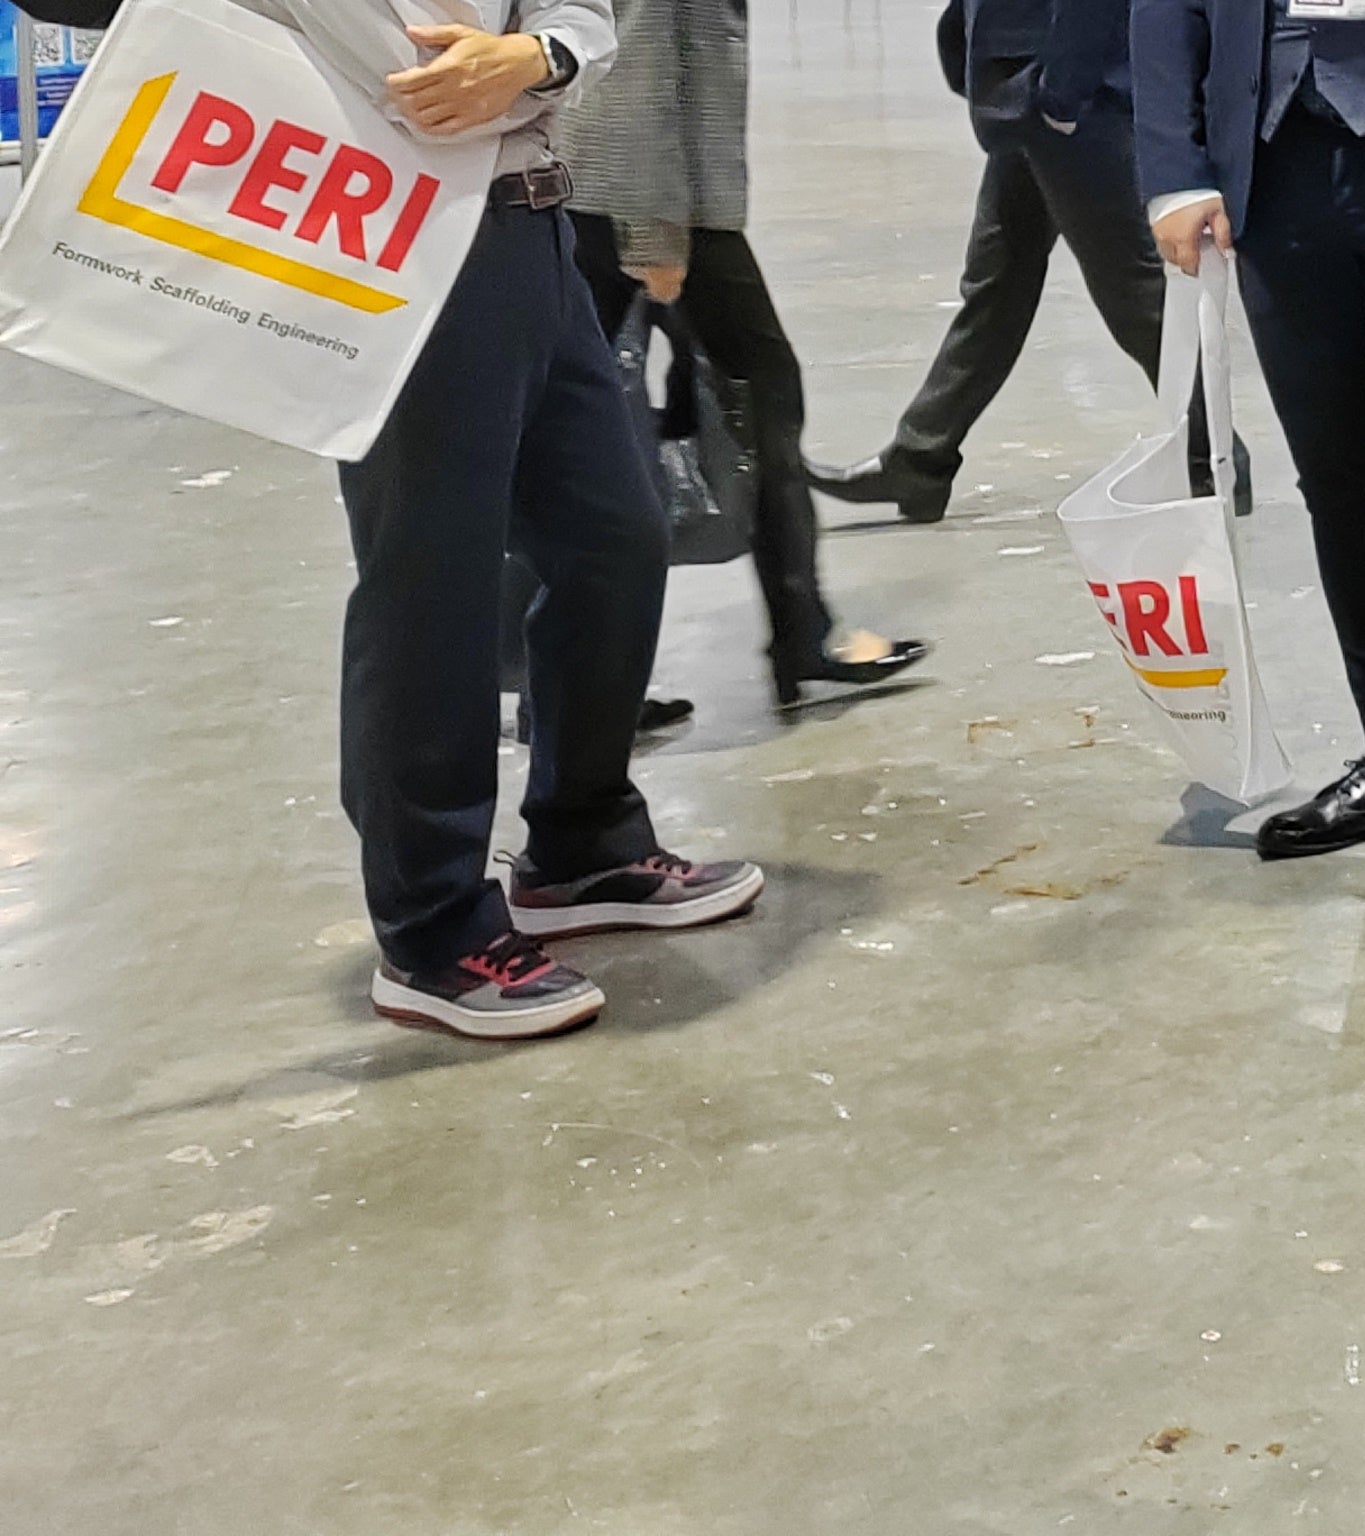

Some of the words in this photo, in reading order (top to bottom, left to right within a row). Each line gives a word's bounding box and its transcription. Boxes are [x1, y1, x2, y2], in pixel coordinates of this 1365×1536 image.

[151, 90, 441, 273] PERI
[51, 240, 143, 286] Formwork
[149, 276, 252, 326] Scaffolding
[256, 312, 360, 361] Engineering
